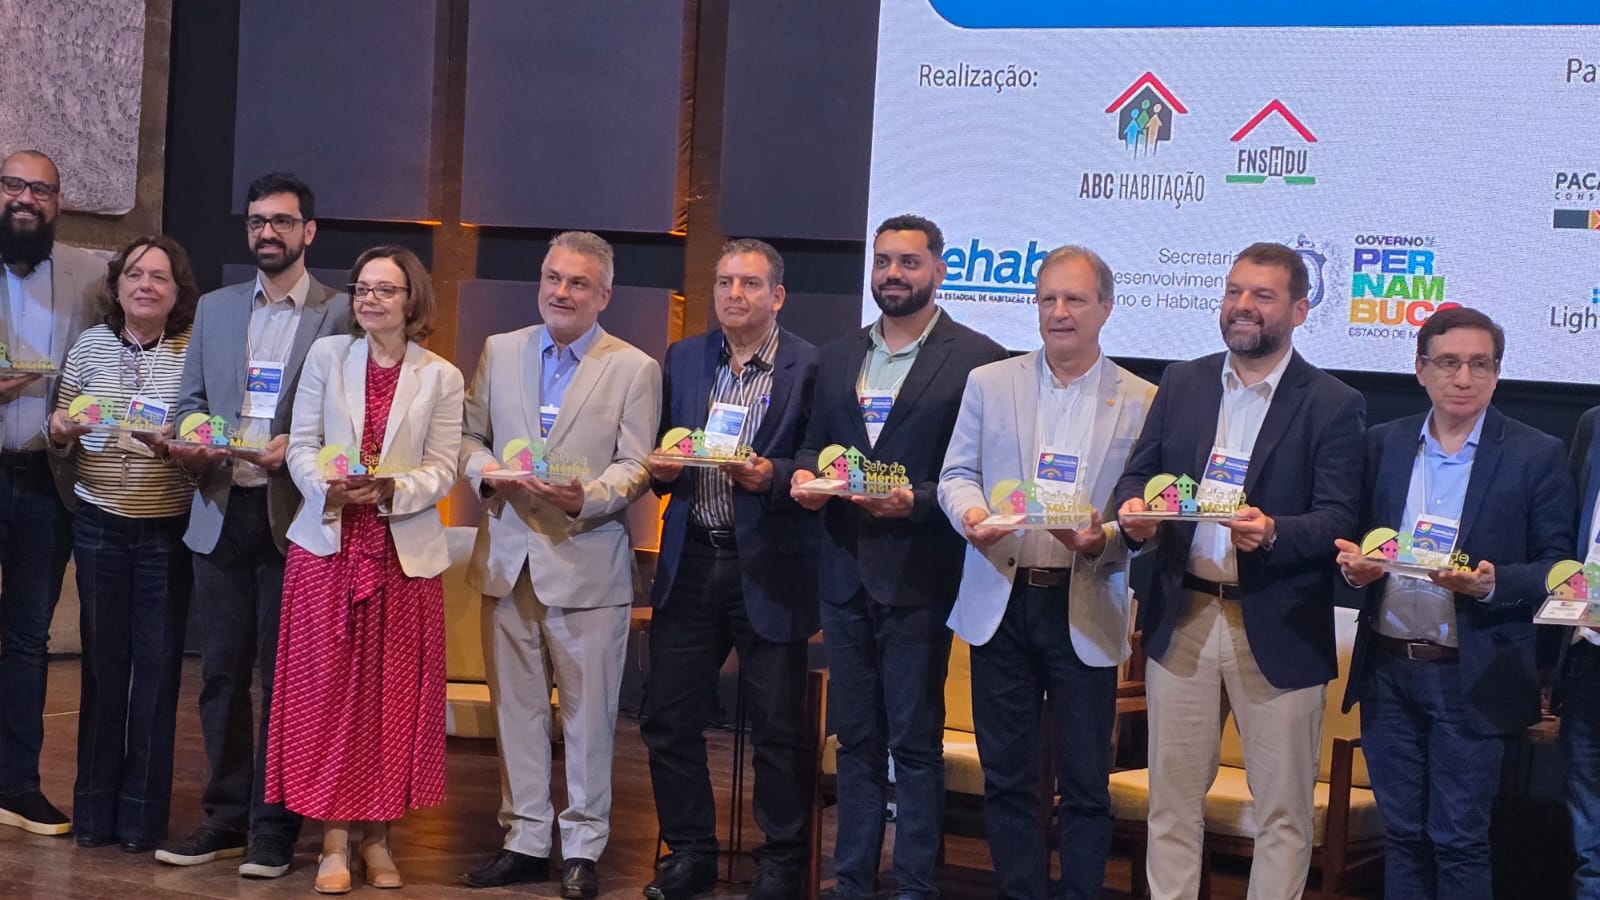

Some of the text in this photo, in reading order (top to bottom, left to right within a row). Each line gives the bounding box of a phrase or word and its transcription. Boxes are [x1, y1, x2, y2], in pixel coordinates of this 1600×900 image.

[919, 62, 1039, 94] Realização:
[1566, 58, 1600, 83] Pa
[1079, 171, 1205, 209] ABC HABITAÇÃO
[1555, 171, 1600, 190] PAC
[1354, 233, 1425, 247] GOVERNO
[943, 239, 1048, 285] ehab
[1353, 248, 1435, 275] PER
[1113, 271, 1228, 288] esenvolvimen
[1351, 273, 1446, 301] NAM
[1141, 294, 1152, 307] e
[1349, 299, 1463, 327] BUC
[1550, 305, 1600, 333] Ligh
[1348, 327, 1390, 339] ESTADO
[863, 460, 906, 474] Selo de
